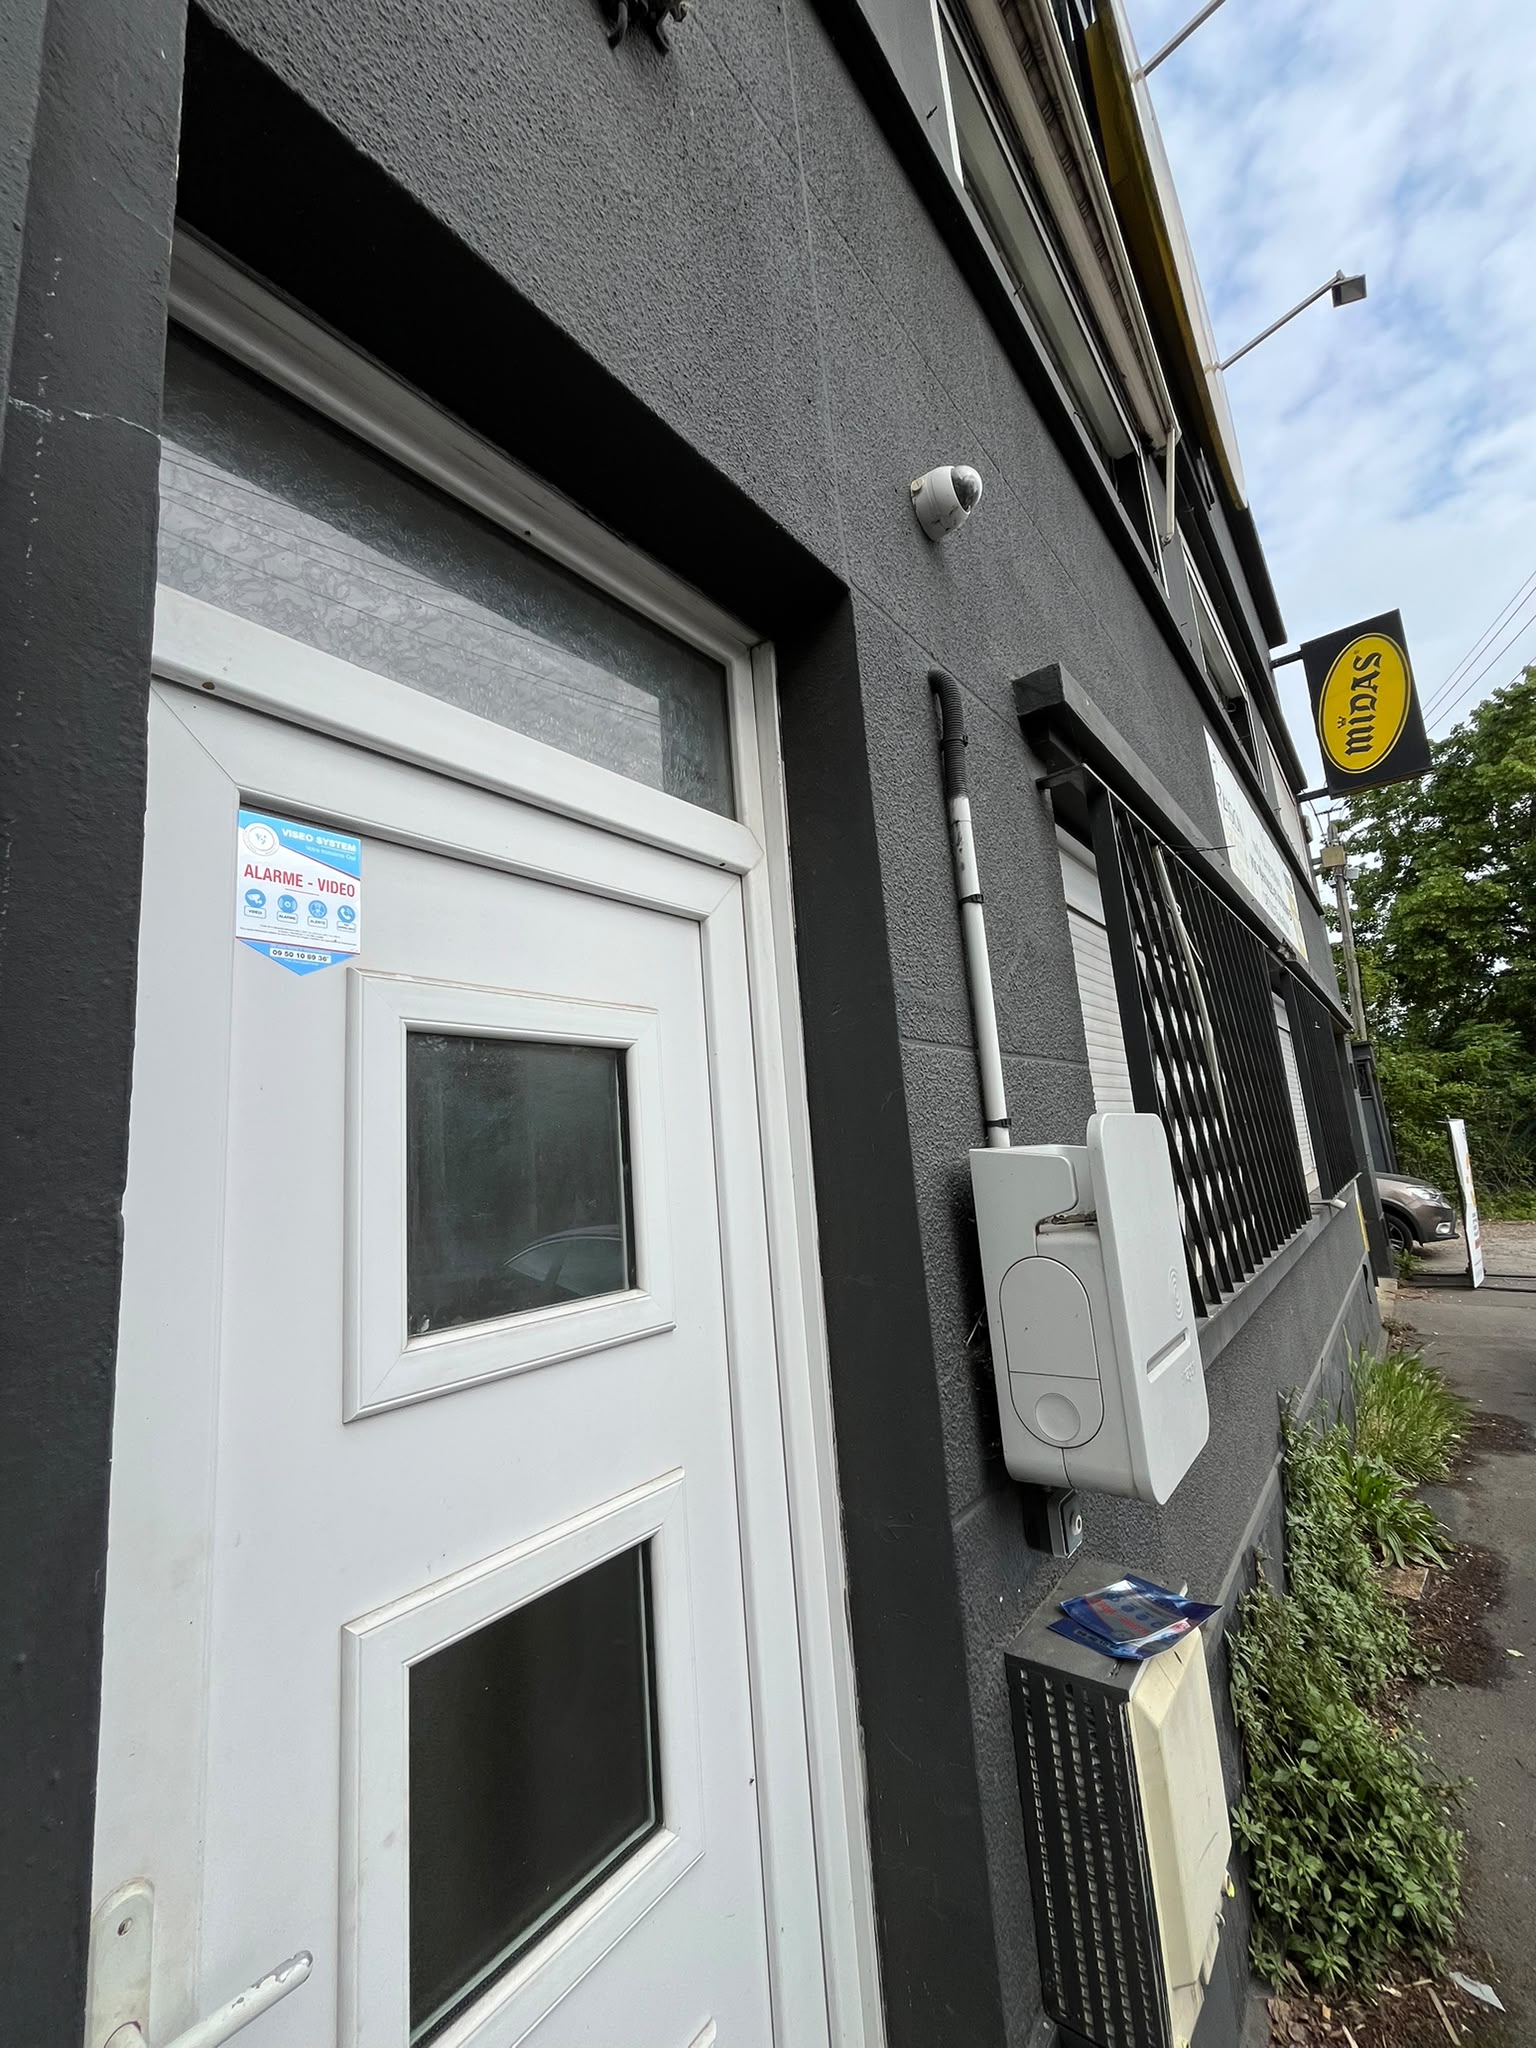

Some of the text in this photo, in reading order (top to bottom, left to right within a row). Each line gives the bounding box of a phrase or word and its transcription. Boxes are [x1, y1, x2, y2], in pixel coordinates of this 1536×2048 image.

[1343, 650, 1384, 758] MIDAS
[282, 828, 356, 852] VISEO SYSTEM
[244, 863, 303, 888] ALARME
[317, 877, 355, 898] VIDEO
